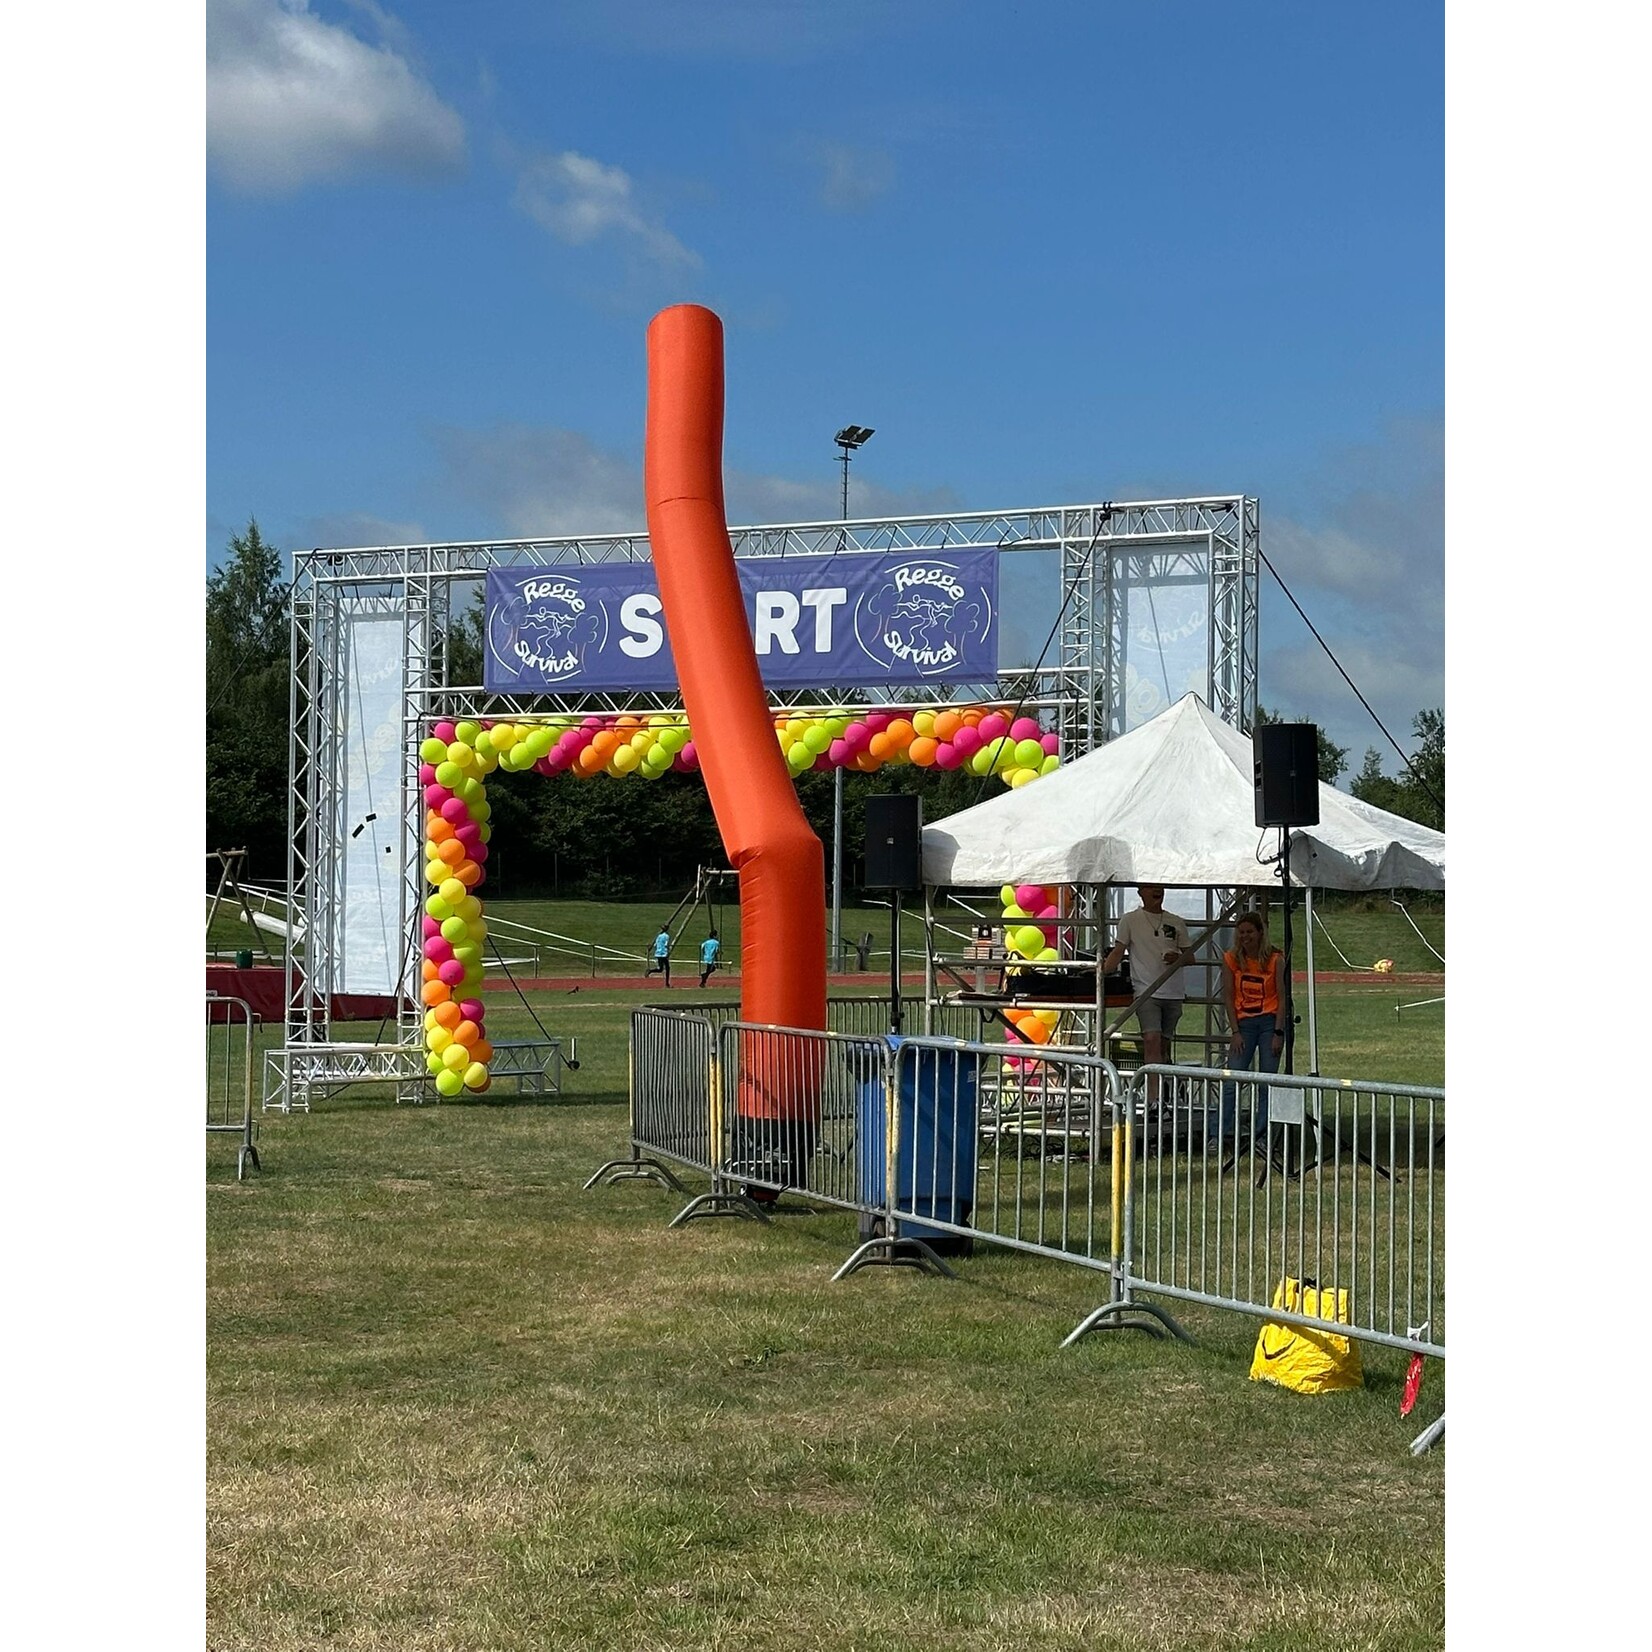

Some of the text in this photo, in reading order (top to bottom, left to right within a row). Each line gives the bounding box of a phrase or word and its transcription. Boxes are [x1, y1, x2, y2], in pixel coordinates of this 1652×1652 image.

[523, 581, 586, 613] Regge
[894, 566, 965, 601] Regge
[618, 587, 848, 659] SRT
[513, 639, 579, 673] Survival
[883, 630, 958, 665] Survival
